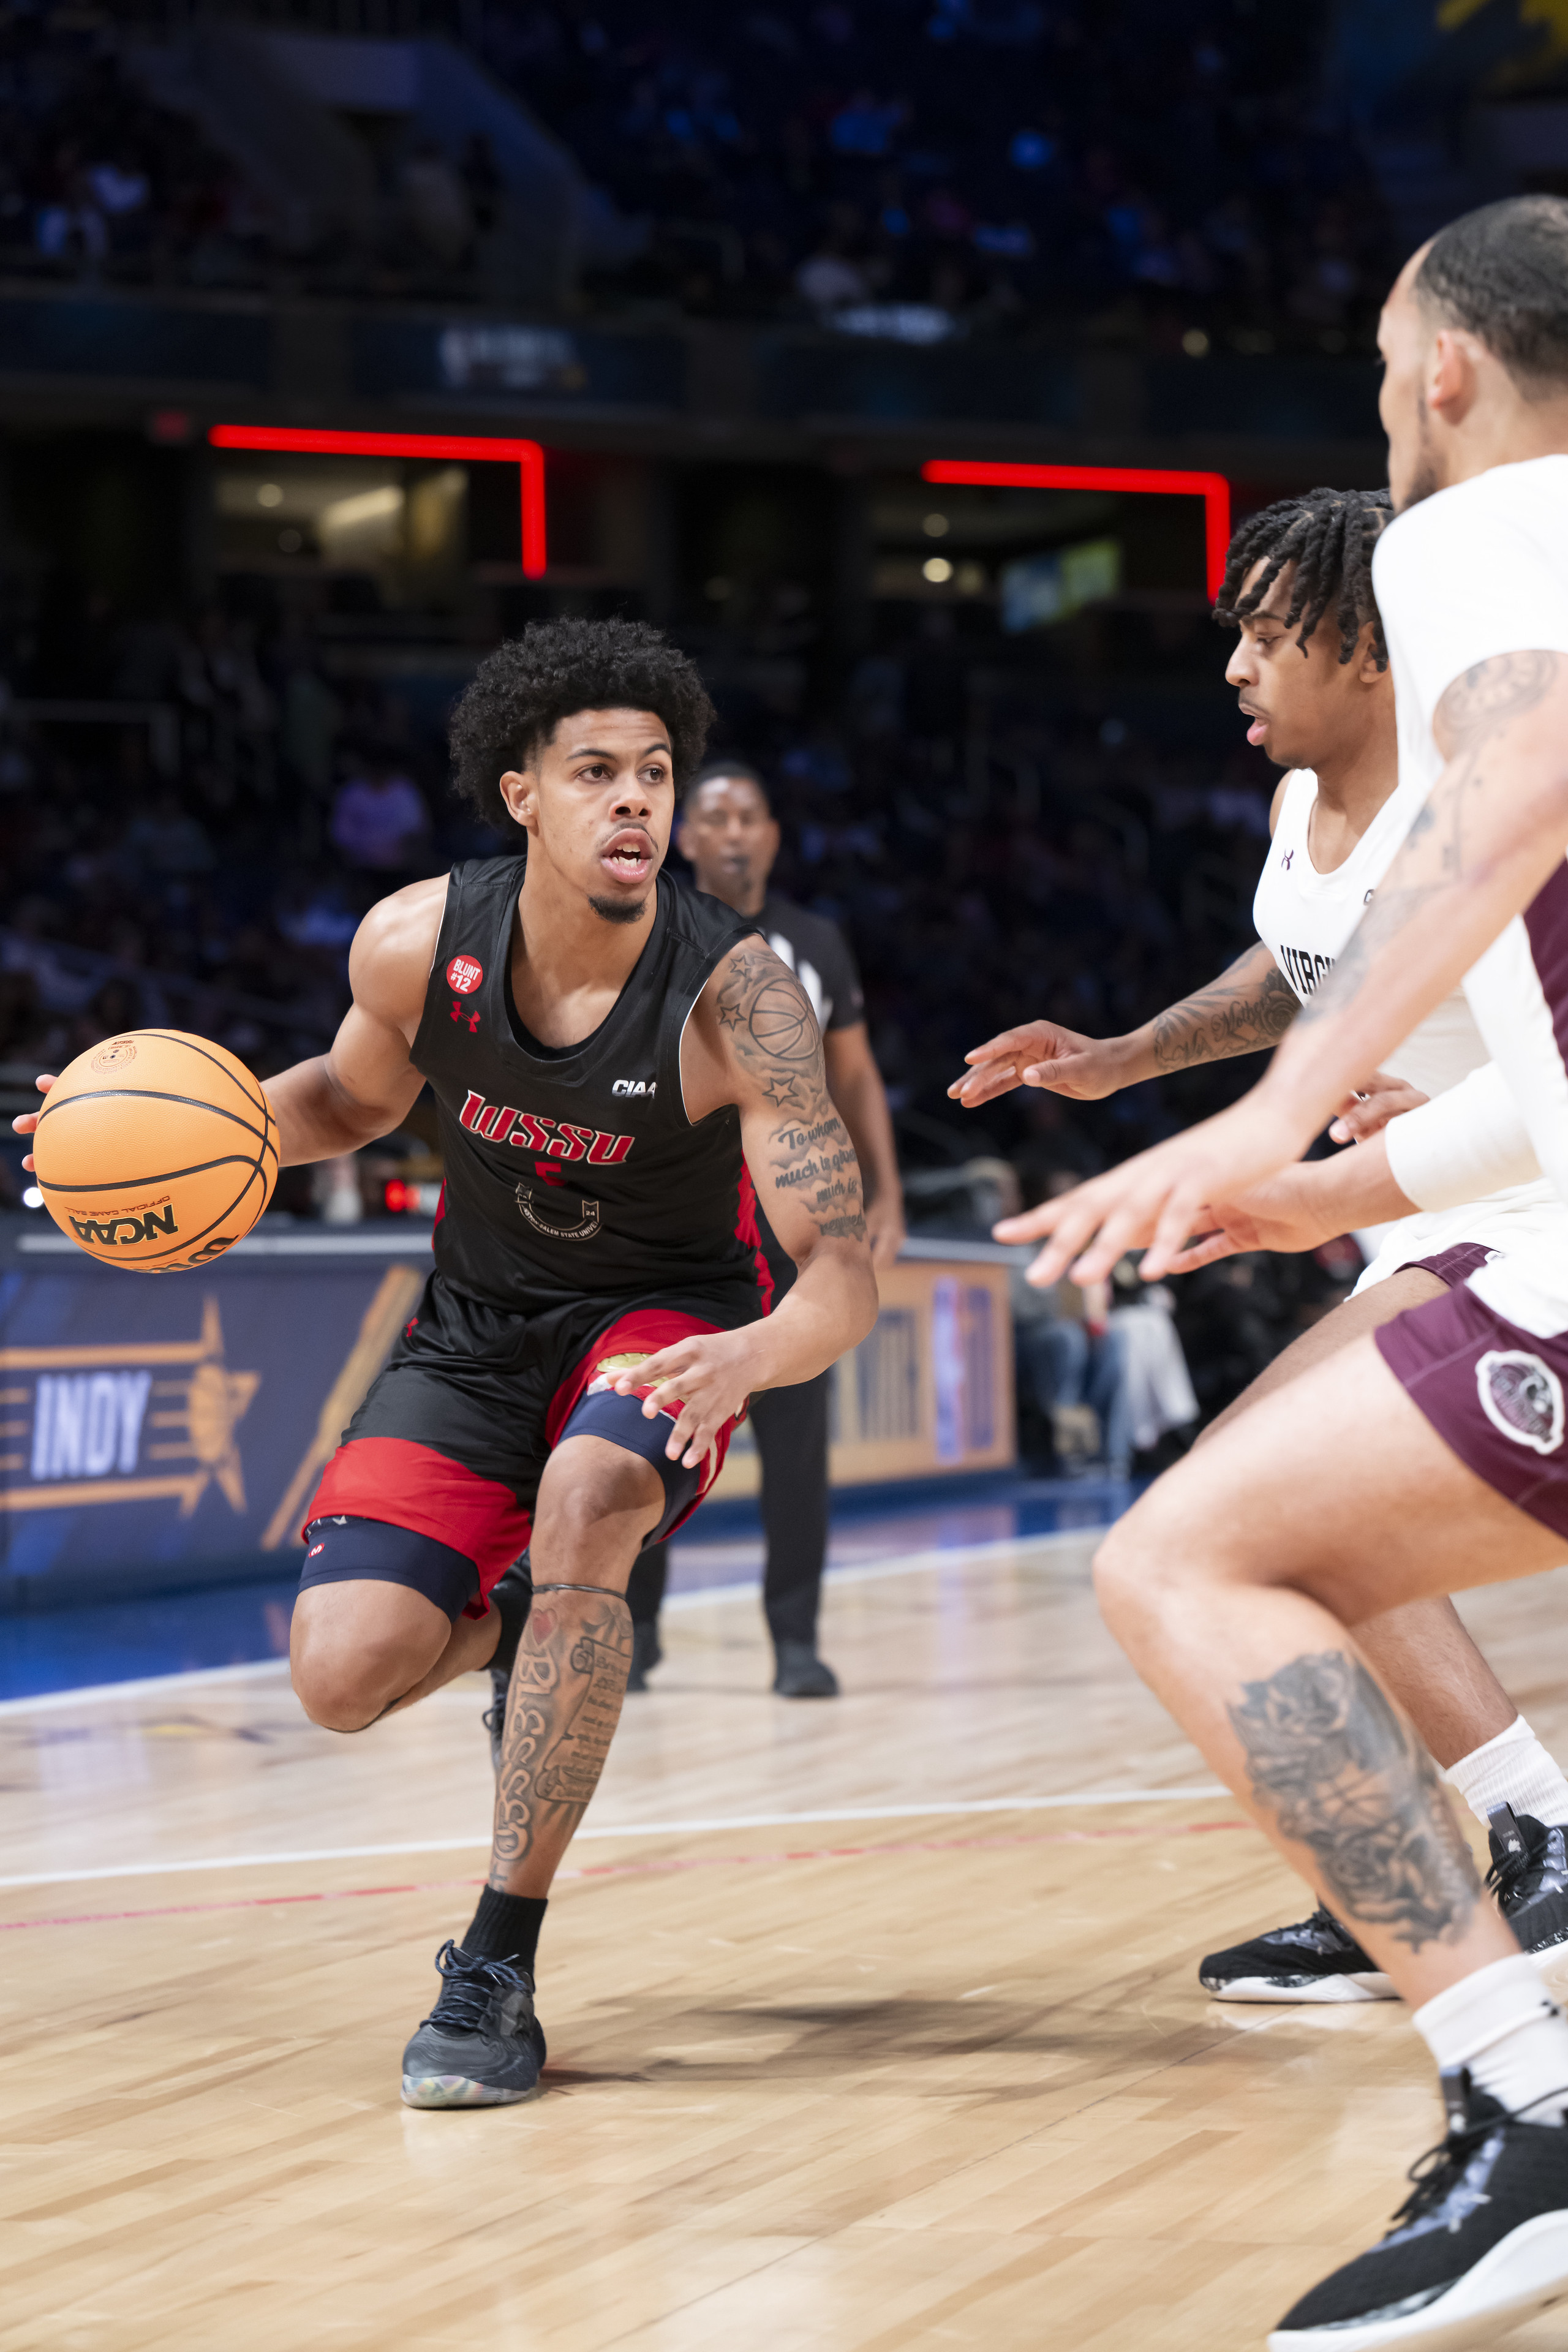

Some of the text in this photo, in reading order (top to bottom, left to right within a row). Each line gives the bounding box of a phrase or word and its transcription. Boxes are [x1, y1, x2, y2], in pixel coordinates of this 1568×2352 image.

[450, 971, 472, 992] #12
[453, 959, 481, 980] BLUNT
[612, 1079, 657, 1099] CIAA
[459, 1089, 636, 1164] WSSU
[778, 1117, 841, 1150] To whom
[775, 1159, 820, 1189] much
[819, 1155, 831, 1171] is
[121, 1196, 171, 1213] OFFICIAL
[816, 1177, 858, 1204] much is
[68, 1204, 179, 1246] NCAA
[31, 1370, 153, 1480] INDY
